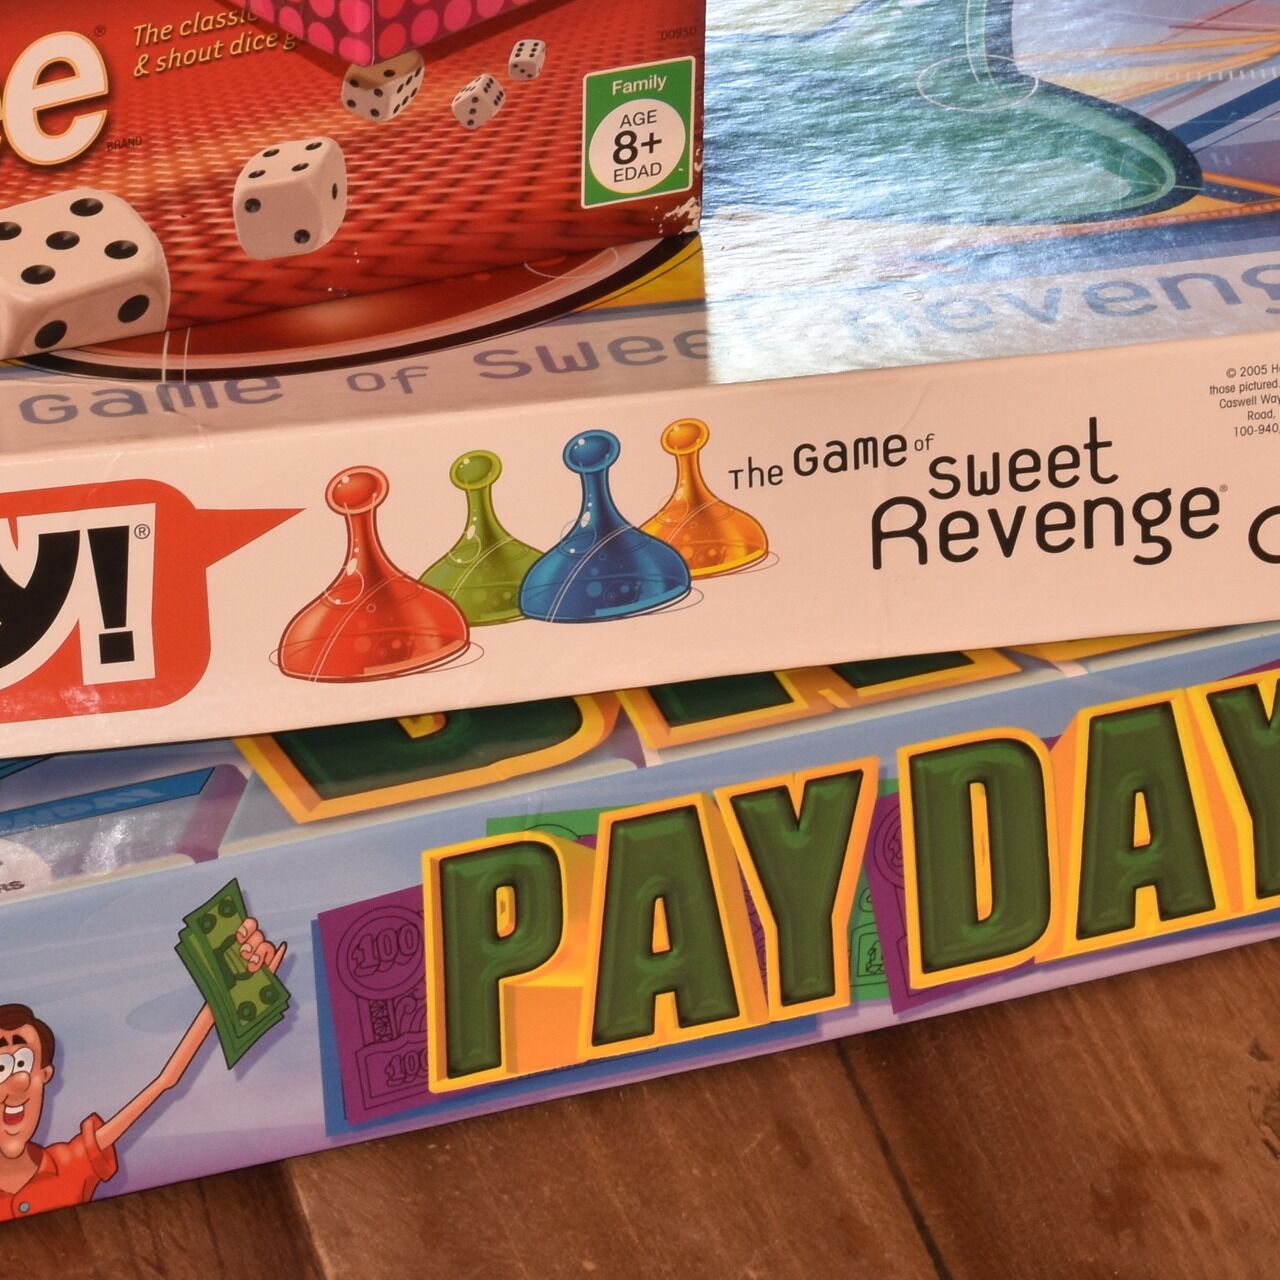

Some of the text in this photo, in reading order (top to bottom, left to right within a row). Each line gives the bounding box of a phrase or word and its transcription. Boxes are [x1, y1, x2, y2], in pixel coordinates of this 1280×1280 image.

[133, 23, 173, 47] The
[133, 59, 149, 77] &
[155, 41, 223, 73] shout
[228, 32, 278, 59] dice
[612, 74, 667, 96] Family
[620, 109, 657, 128] AGE
[107, 136, 143, 152] BRAND
[613, 130, 662, 165] 8+
[613, 162, 662, 183] EDAD
[20, 370, 283, 432] Game
[347, 364, 430, 397] of
[728, 432, 936, 491] The Game of
[871, 485, 1222, 571] Revenge
